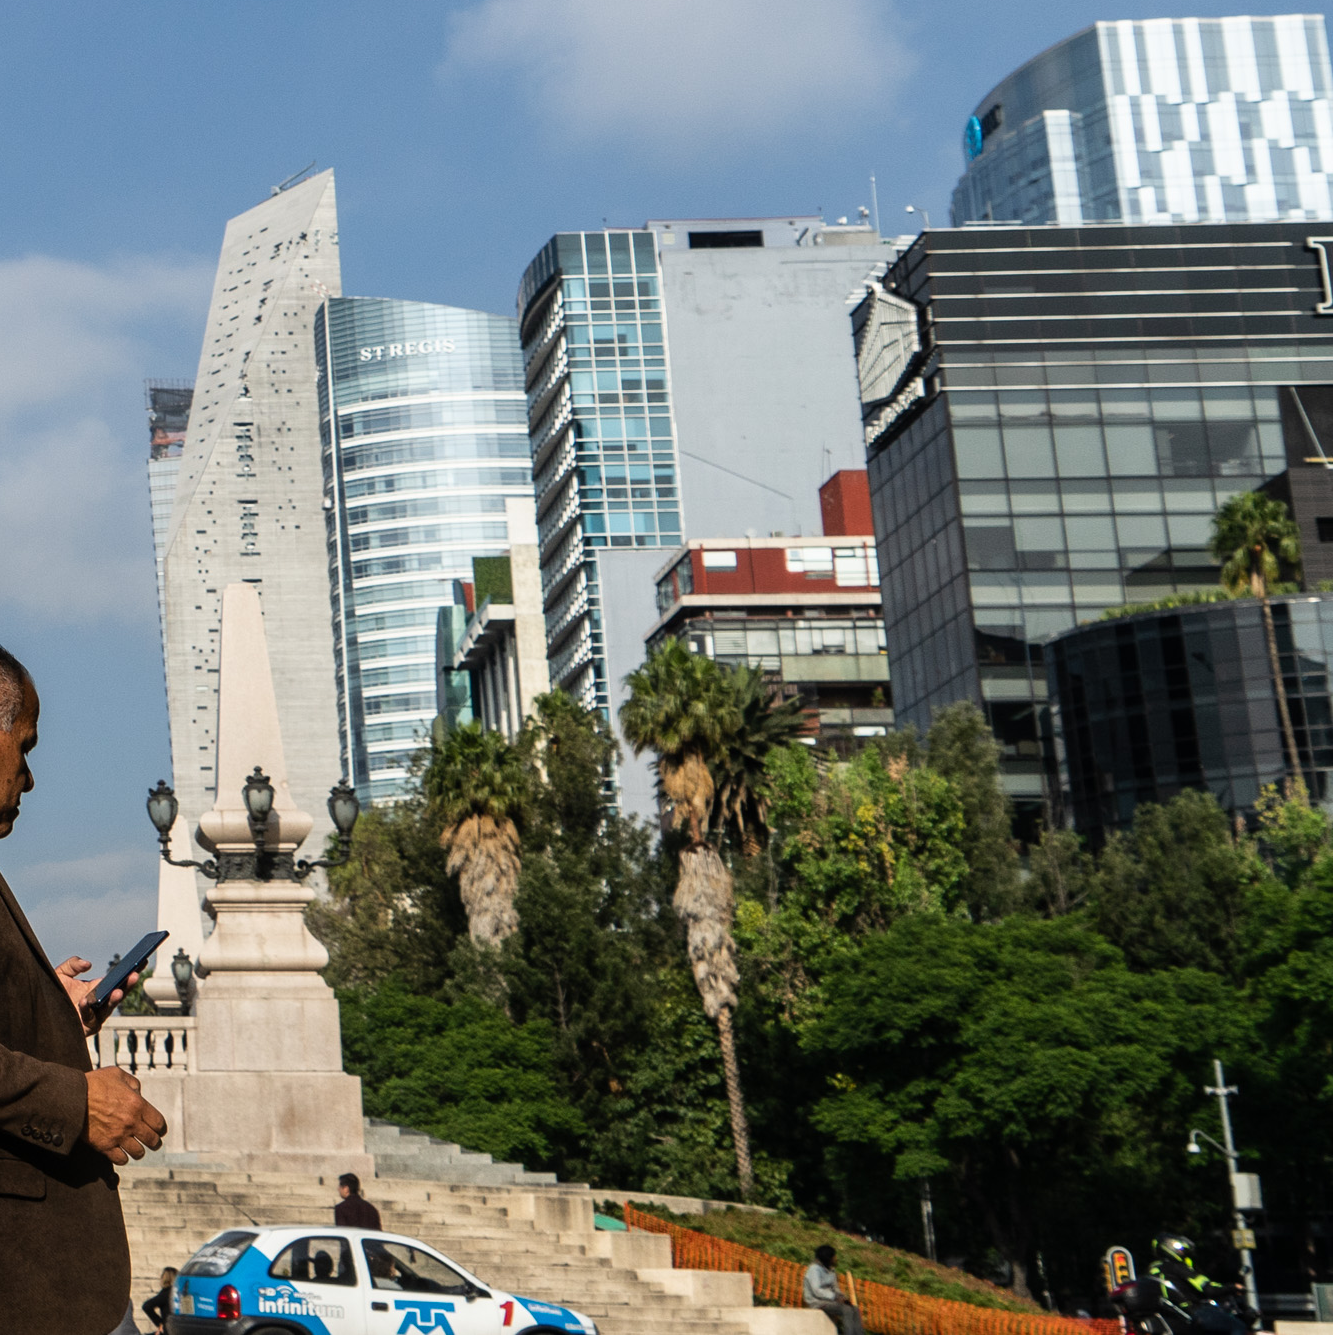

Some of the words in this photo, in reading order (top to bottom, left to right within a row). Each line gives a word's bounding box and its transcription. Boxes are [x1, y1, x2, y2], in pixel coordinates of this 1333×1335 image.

[389, 338, 456, 357] REGIS
[258, 1296, 345, 1319] infinitum
[499, 1301, 514, 1326] 1
